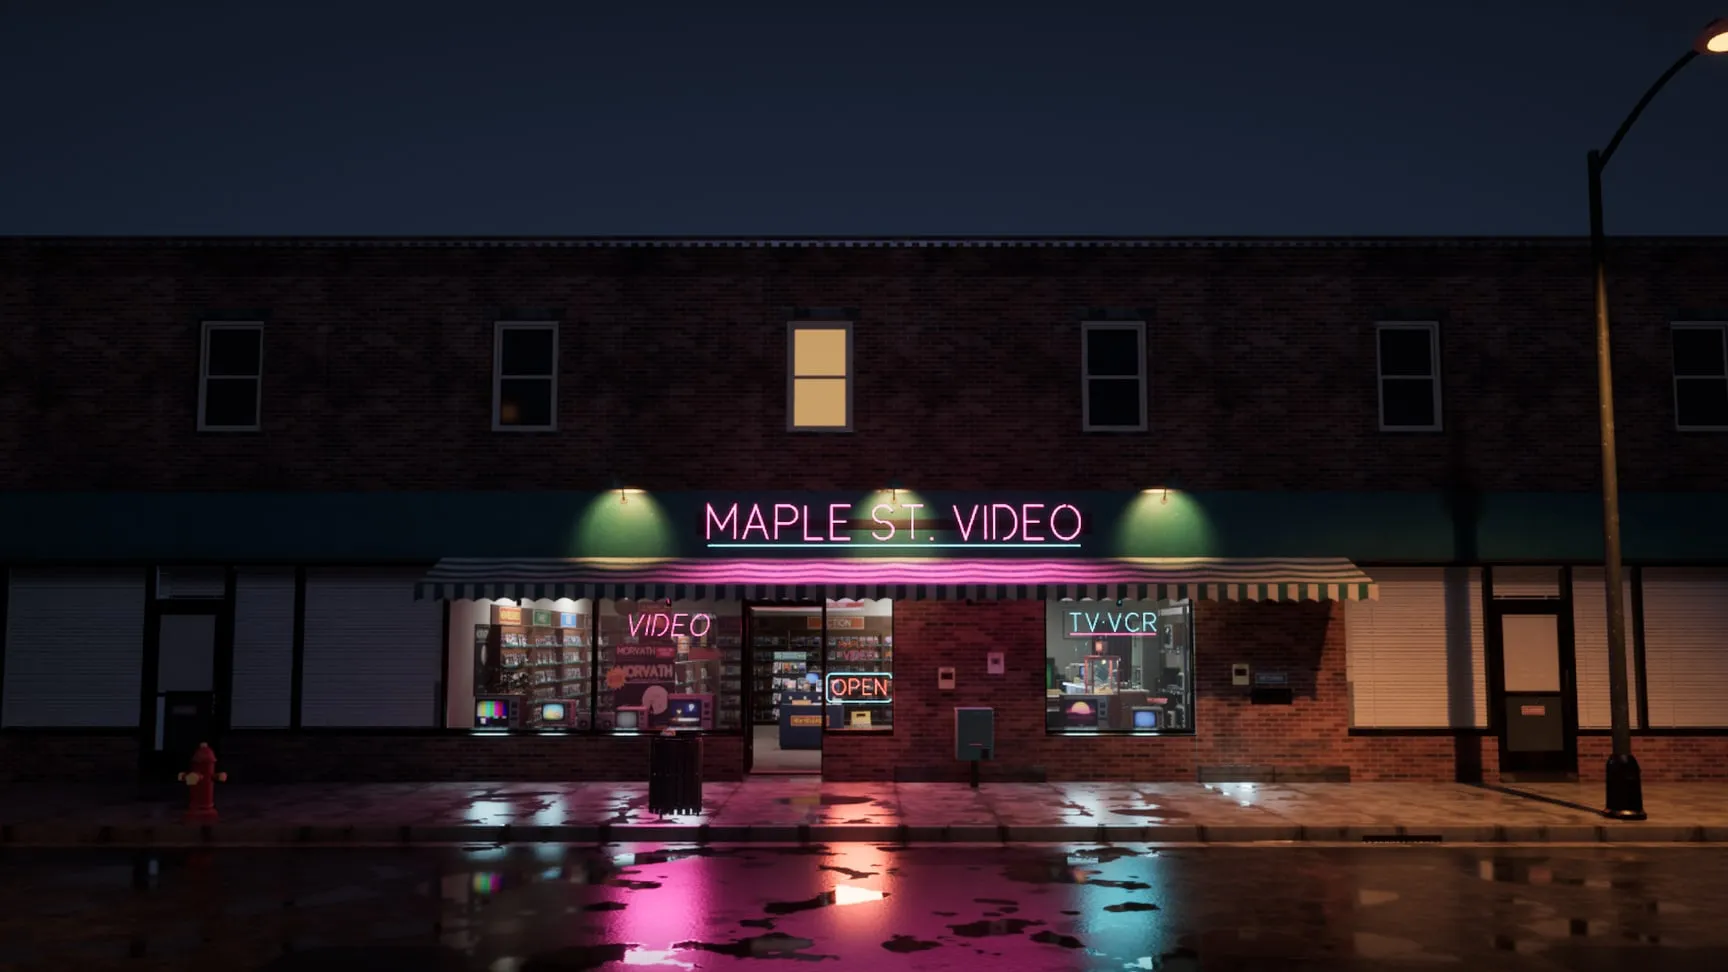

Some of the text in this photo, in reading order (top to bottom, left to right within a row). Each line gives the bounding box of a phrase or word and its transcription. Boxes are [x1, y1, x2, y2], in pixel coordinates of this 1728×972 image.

[705, 502, 1083, 541] MAPLE ST. VIDEO
[628, 613, 711, 637] VIDEO
[831, 678, 888, 696] OPEN
